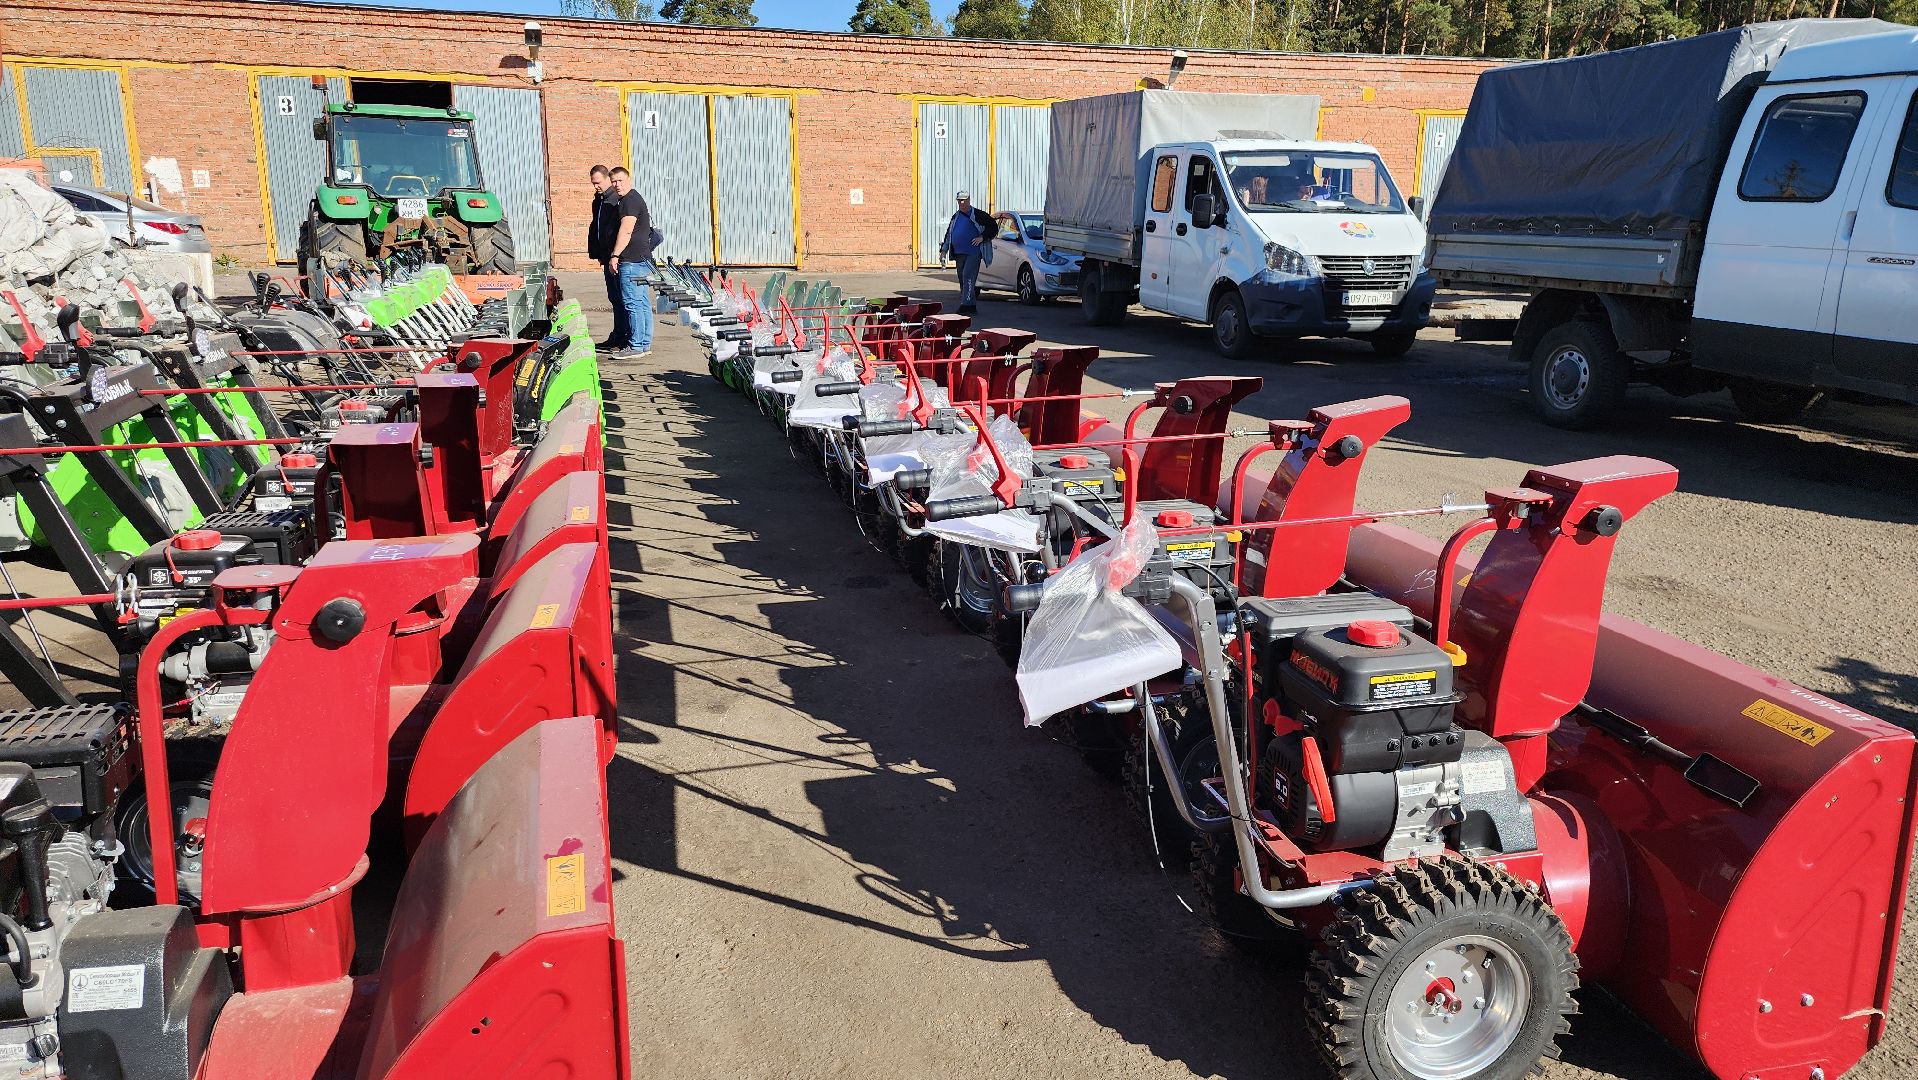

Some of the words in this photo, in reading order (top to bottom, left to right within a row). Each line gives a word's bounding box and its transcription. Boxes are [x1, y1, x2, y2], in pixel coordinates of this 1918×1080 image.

[281, 98, 292, 113] 3
[647, 113, 656, 126] 4
[936, 123, 945, 136] 5
[402, 200, 424, 208] 4286
[1403, 568, 1437, 594] 13
[1275, 778, 1288, 797] 8.0
